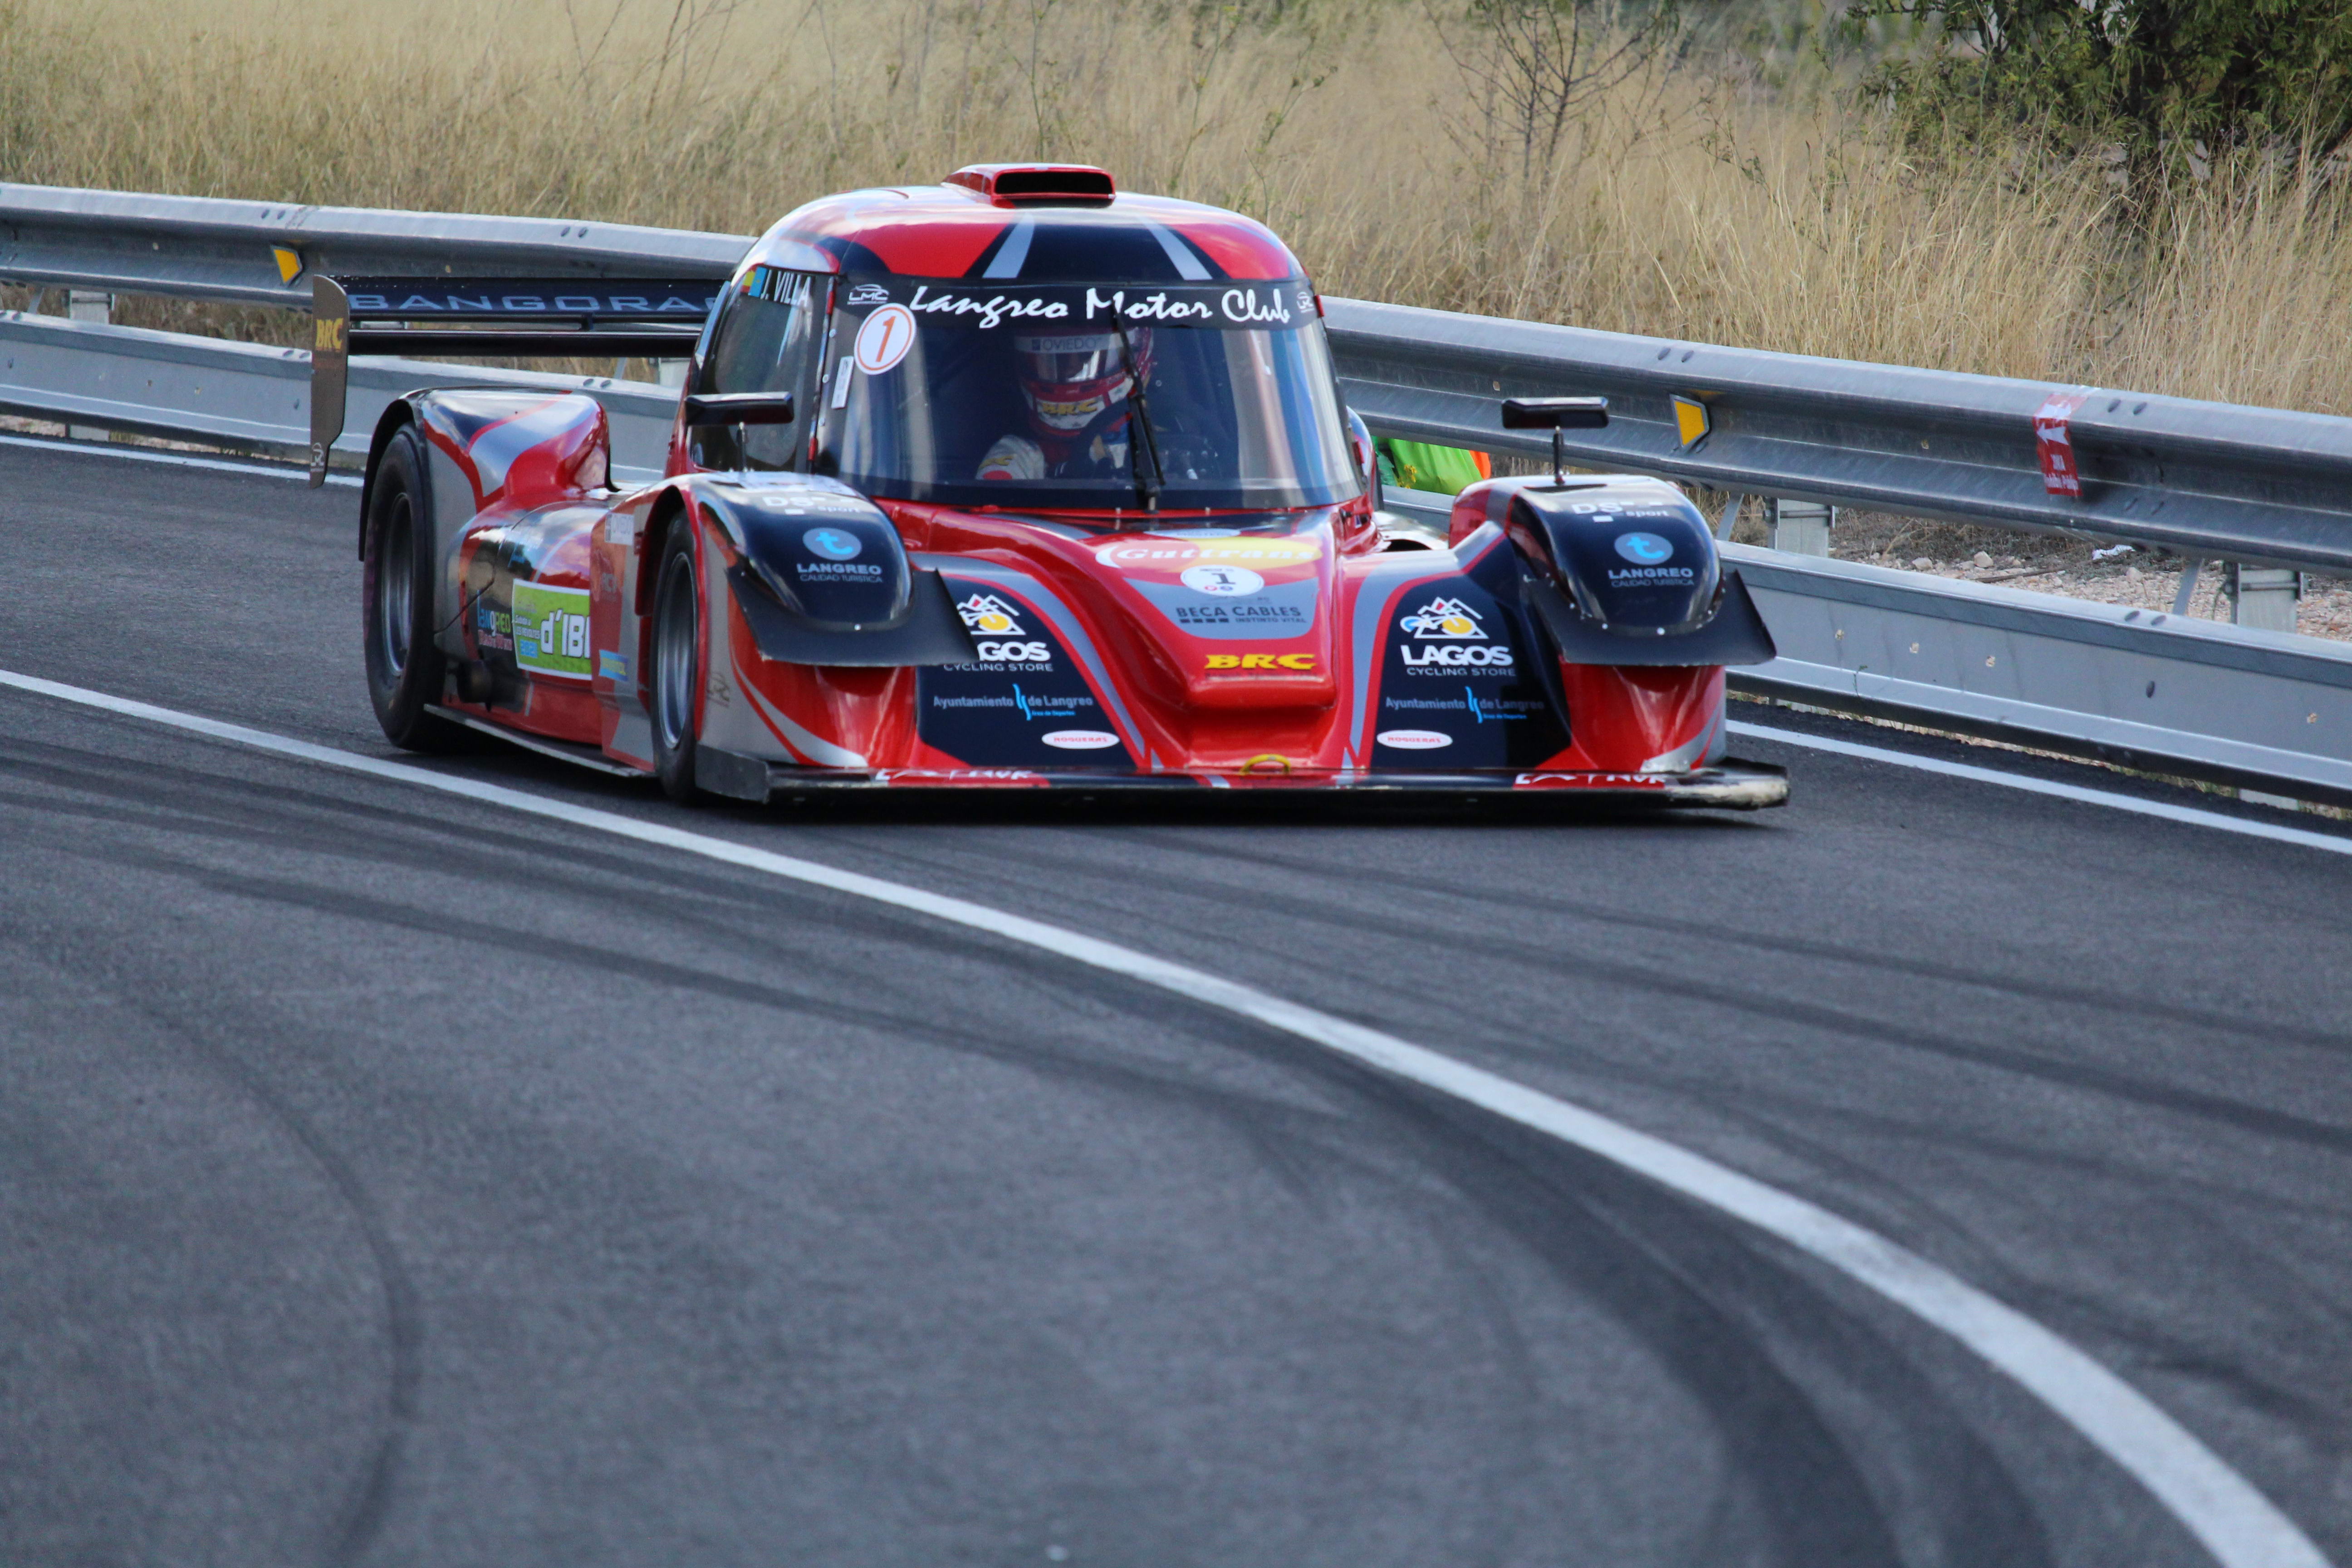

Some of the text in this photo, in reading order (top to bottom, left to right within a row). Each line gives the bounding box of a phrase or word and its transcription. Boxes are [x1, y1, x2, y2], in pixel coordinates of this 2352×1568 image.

[774, 271, 811, 307] VILLA
[909, 286, 1290, 328] Langreo Motor Club
[315, 318, 344, 350] BRC
[875, 316, 897, 363] 1
[1044, 338, 1097, 350] OVIEDO
[1043, 400, 1098, 416] BRC
[796, 563, 882, 575] LANGREO
[1608, 568, 1694, 579] LANGREO
[1211, 573, 1236, 584] 1
[1176, 606, 1301, 617] BECA CABLES
[977, 641, 1051, 662] GOS
[1401, 645, 1514, 666] LAGOS
[943, 663, 1054, 672] CYCLING STORE
[1204, 653, 1317, 670] BRC
[1406, 667, 1516, 676] CYCLING STORE
[933, 695, 1093, 709] Ayuntamiento de Langreo
[1386, 696, 1544, 711] Ayuntamiento de Langreo
